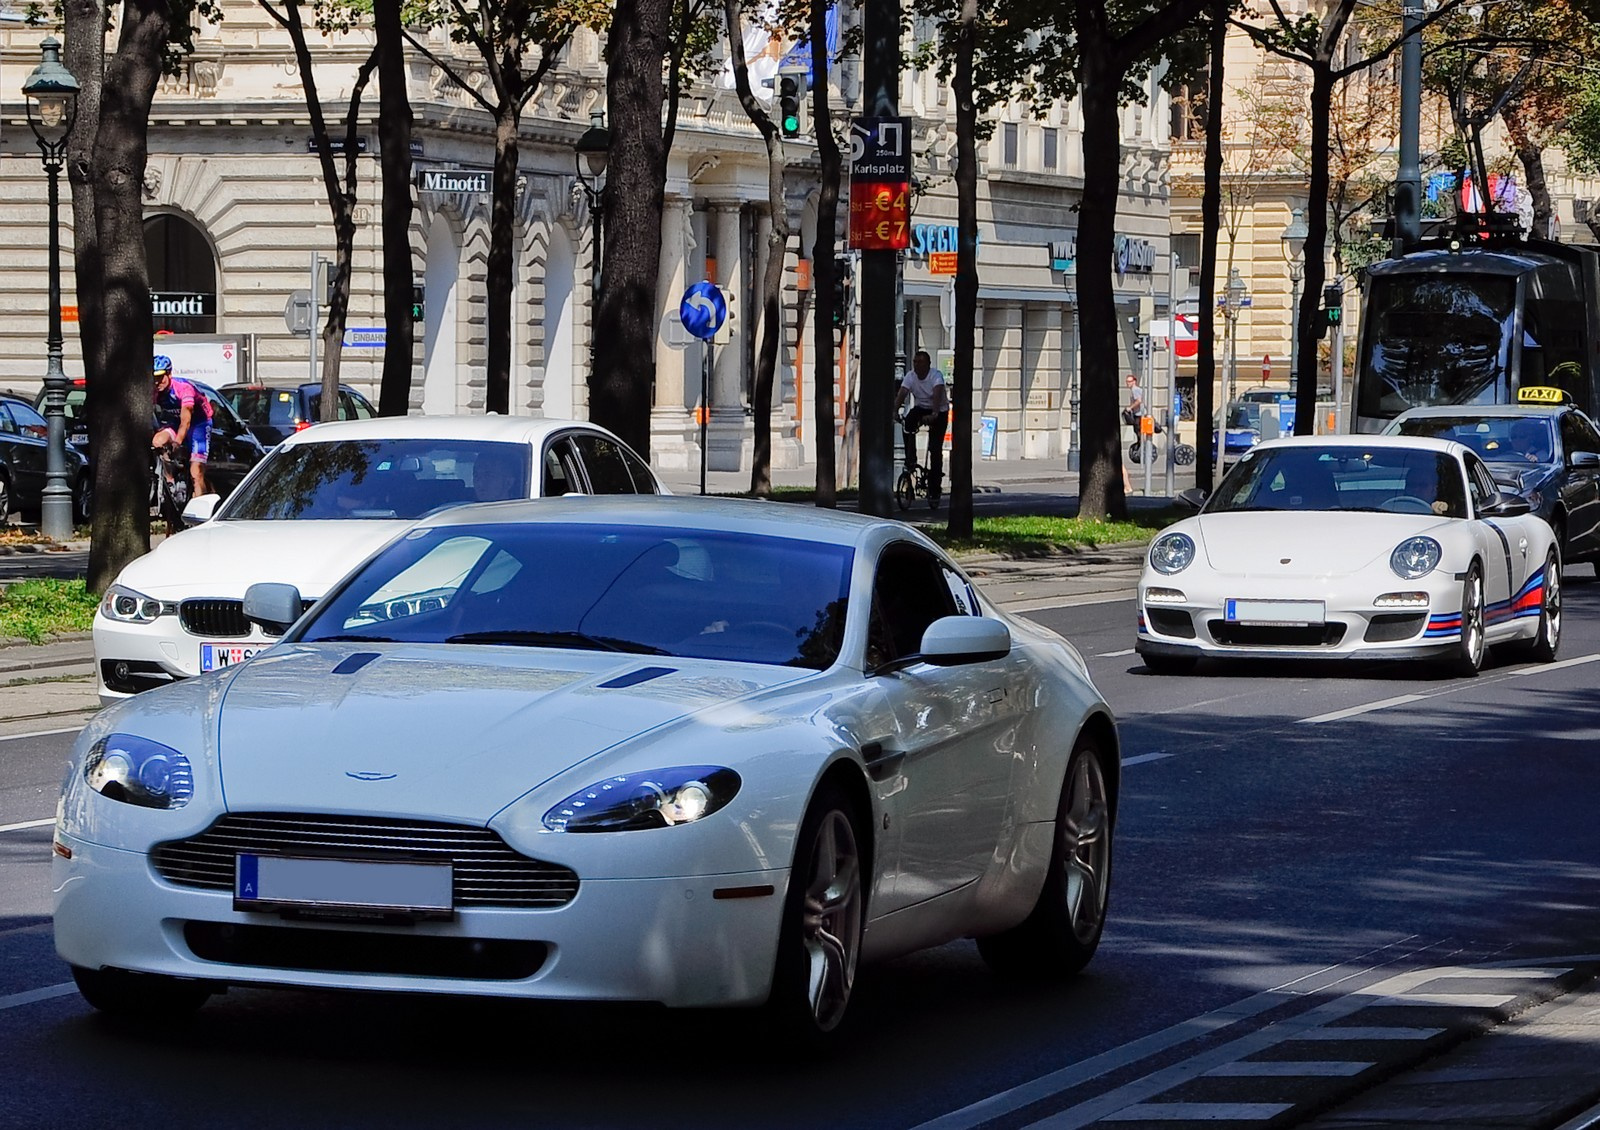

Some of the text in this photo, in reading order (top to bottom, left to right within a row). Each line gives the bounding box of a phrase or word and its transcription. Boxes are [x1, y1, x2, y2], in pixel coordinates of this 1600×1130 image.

[854, 164, 905, 175] Karlsplatz
[423, 173, 487, 192] Minotti
[149, 295, 203, 315] inotti
[1524, 389, 1554, 399] TAXI
[218, 649, 229, 667] W
[244, 882, 253, 893] A
